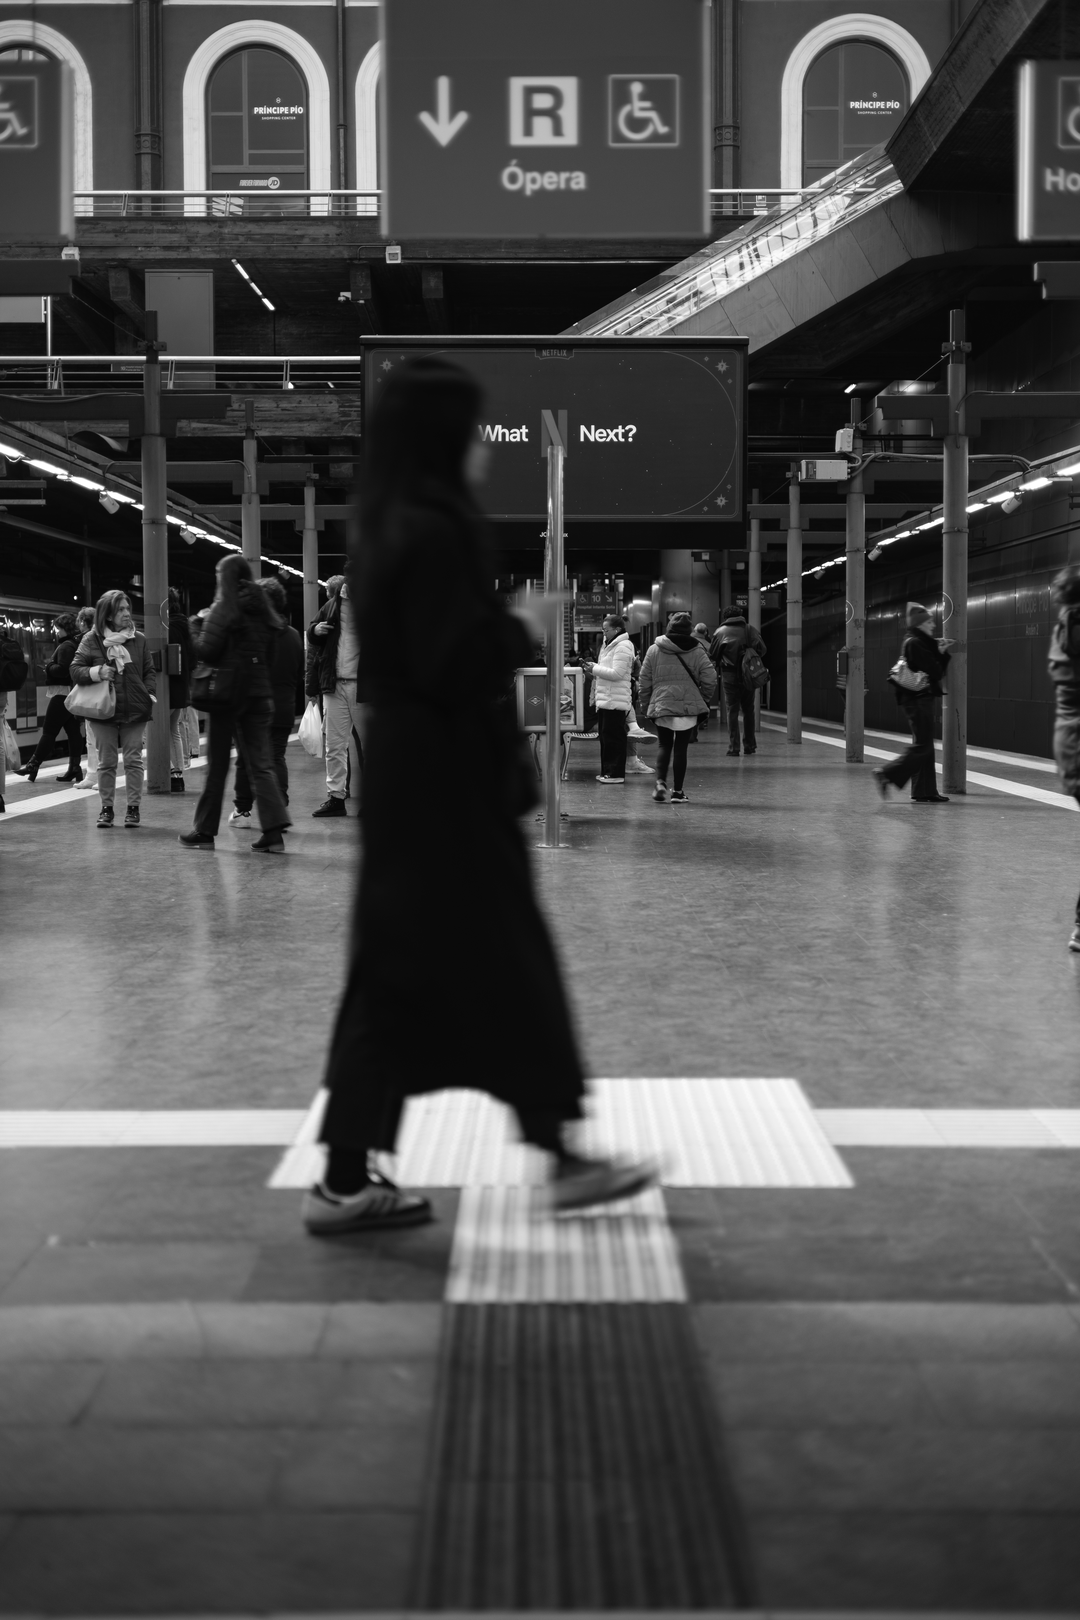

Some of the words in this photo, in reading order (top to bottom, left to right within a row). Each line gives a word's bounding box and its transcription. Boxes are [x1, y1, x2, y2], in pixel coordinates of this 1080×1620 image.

[254, 104, 289, 114] PRÍNCIPE
[290, 104, 304, 114] PÍO
[850, 100, 885, 108] PRÍNCIPE
[886, 100, 900, 108] PÍO
[521, 83, 566, 139] R
[501, 159, 587, 196] Ópera
[542, 349, 568, 357] NETFLIX
[478, 424, 529, 442] What
[580, 424, 638, 442] Next?
[592, 594, 600, 602] 10
